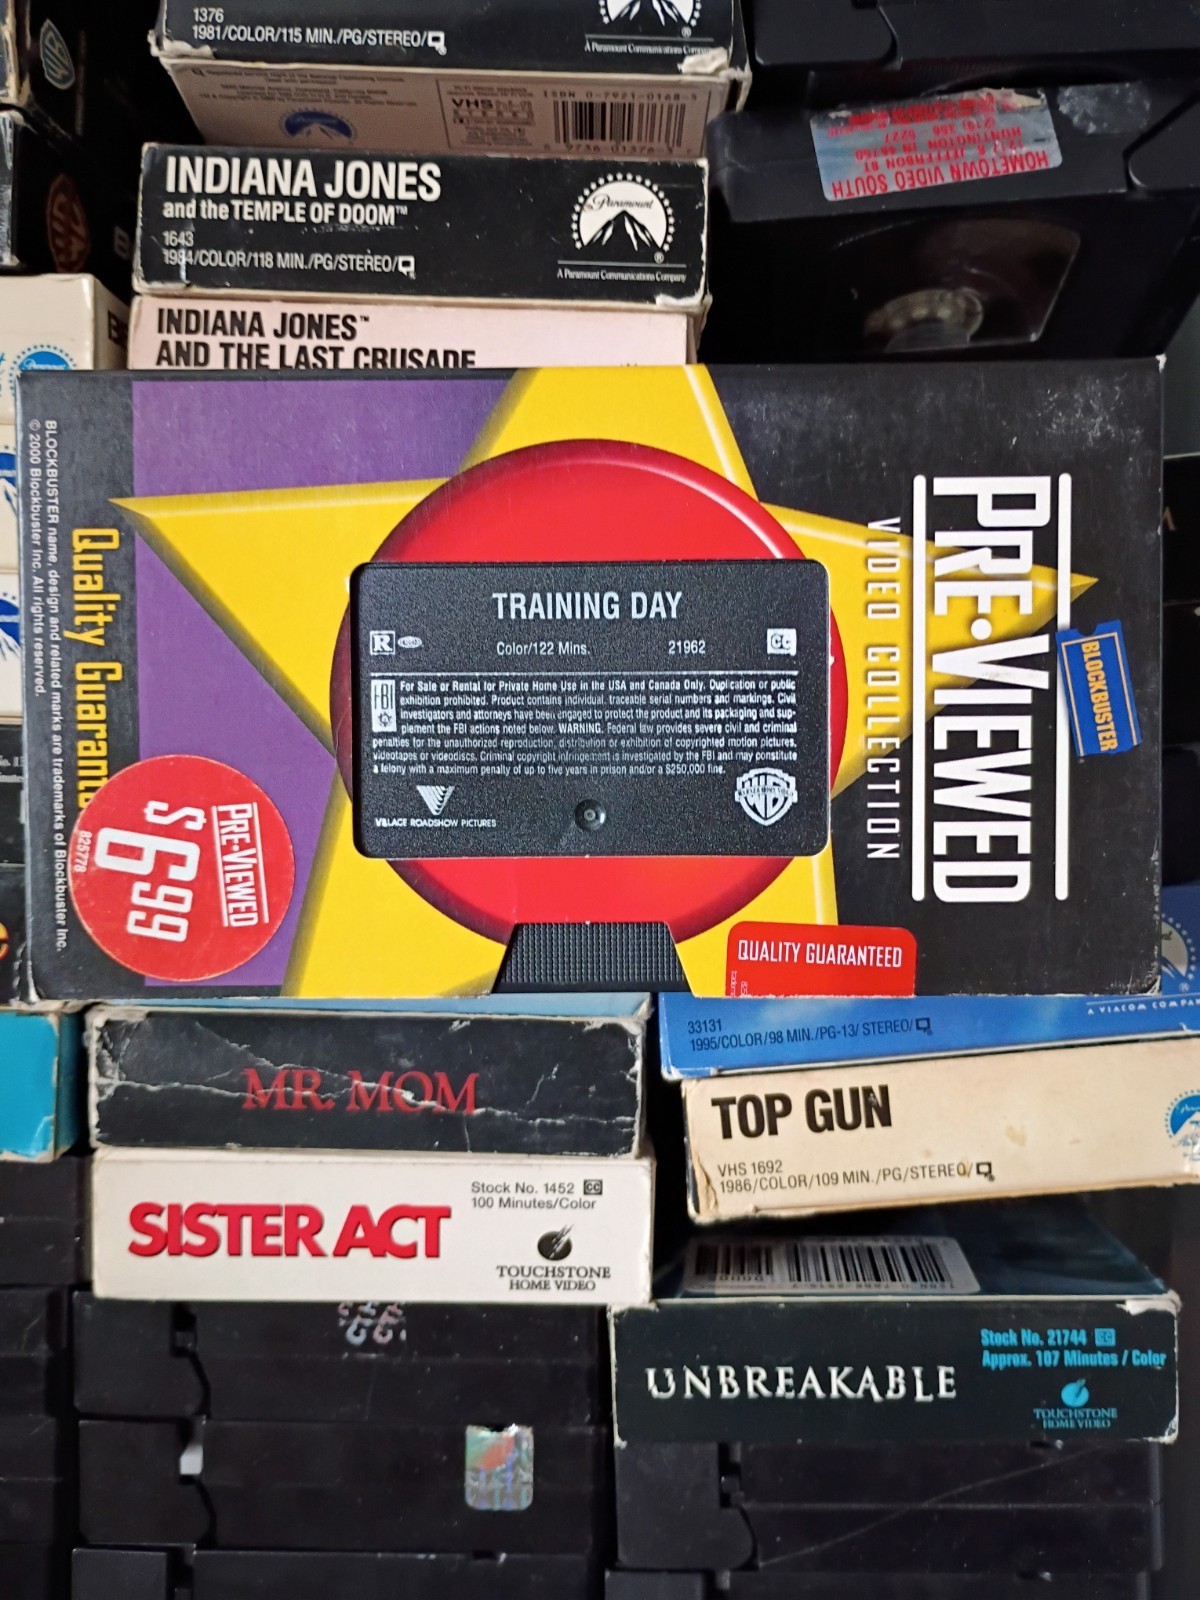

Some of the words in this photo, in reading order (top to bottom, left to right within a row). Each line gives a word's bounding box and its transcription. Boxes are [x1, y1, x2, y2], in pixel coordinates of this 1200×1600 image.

[194, 7, 224, 23] 1376
[192, 25, 302, 43] 1981/COLOR/115
[305, 28, 428, 47] MIN./PG/STEREO/
[949, 150, 1048, 183] HOMETOWN
[165, 156, 317, 197] INDIANA
[325, 160, 441, 201] JONES
[832, 174, 887, 198] SOUTH
[894, 167, 944, 189] VIDEO
[163, 199, 196, 218] and
[201, 199, 229, 220] the
[231, 200, 305, 222] TEMPLE
[310, 203, 335, 223] OF
[592, 193, 654, 210] Paramount
[163, 231, 194, 247] 1643
[277, 253, 398, 272] MIN./PG/STEREO/
[564, 269, 599, 279] Paramount
[656, 272, 686, 282] Company
[157, 308, 264, 337] INDIANA
[156, 340, 209, 367] AND
[220, 342, 270, 369] THE
[280, 345, 344, 369] LAST
[353, 347, 476, 368] CRUSADE
[29, 434, 41, 464] 2000
[45, 420, 60, 523] BLOCKBUSTER
[30, 468, 43, 546] Blockbuster
[46, 527, 58, 566] name,
[32, 550, 44, 572] Inc.
[867, 518, 900, 619] VIDEO
[32, 576, 45, 593] All
[47, 570, 61, 613] design
[63, 528, 122, 646] Quality
[30, 597, 45, 634] rights
[493, 592, 620, 620] TRAINING
[632, 591, 683, 620] DAY
[49, 617, 61, 640] and
[497, 641, 554, 655] Color/122
[558, 640, 590, 655] Mins.
[668, 640, 705, 654] 21962
[34, 637, 47, 697] reserved.
[50, 645, 62, 686] related
[400, 681, 414, 691] For
[418, 681, 436, 691] Sale
[440, 683, 449, 691] or
[453, 681, 480, 691] Rental
[499, 681, 529, 691] Private
[532, 681, 557, 691] Home
[561, 681, 576, 691] Use
[580, 681, 588, 690] in
[592, 681, 604, 690] the
[609, 680, 626, 690] USA
[630, 680, 645, 690] and
[649, 680, 680, 690] Canada
[759, 680, 768, 689] or
[771, 679, 796, 691] public
[1080, 641, 1118, 751] BLOCKBUSTER
[52, 692, 63, 730] marks
[400, 695, 441, 706] exhibition
[444, 695, 488, 706] prohibited.
[492, 695, 524, 706] Product
[715, 694, 729, 704] and
[400, 709, 453, 721] investigators
[456, 710, 471, 720] and
[474, 710, 512, 721] attorneys
[636, 708, 648, 719] the
[651, 709, 683, 719] product
[685, 709, 700, 718] and
[715, 708, 757, 720] packaging
[759, 708, 774, 717] and
[454, 724, 467, 733] FBI
[744, 722, 759, 732] and
[52, 735, 62, 754] are
[428, 738, 441, 748] the
[445, 738, 497, 748] unauthorized
[867, 647, 900, 859] COLLECTION
[756, 751, 797, 761] constitute
[437, 764, 478, 774] maximum
[601, 764, 626, 775] prison
[53, 758, 66, 830] trademarks
[410, 818, 458, 827] ROADSHOW
[462, 819, 496, 828] PICTURES
[55, 833, 66, 846] of
[74, 830, 92, 873] 825778
[55, 850, 68, 925] Blockbuster
[56, 928, 68, 952] Inc.
[738, 939, 800, 962] QUALITY
[806, 943, 902, 968] GUARANTEED
[1099, 1004, 1146, 1013] VIACOM
[688, 1019, 722, 1034] 33131
[690, 1030, 783, 1051] 1995/COLOR/98
[787, 1023, 859, 1043] MIN./PG-13/
[863, 1019, 913, 1036] STEREO/
[242, 1068, 335, 1112] MR.
[345, 1070, 479, 1116] MOM
[711, 1093, 792, 1140] TOP
[805, 1085, 892, 1133] GUN
[718, 1162, 747, 1177] VHS
[751, 1160, 783, 1174] 1692
[720, 1171, 839, 1194] 1986/COLOR/109
[843, 1163, 973, 1185] MIN./PG/STEREO/
[471, 1181, 510, 1194] Stock
[515, 1182, 538, 1194] No.
[544, 1183, 574, 1194] 1452
[472, 1197, 494, 1208] 100
[499, 1197, 596, 1209] Minutes/Color
[128, 1202, 328, 1258] SISTER
[333, 1204, 451, 1259] ACT
[496, 1265, 611, 1279] TOUCHSTONE
[509, 1279, 550, 1290] HOME
[555, 1280, 595, 1291] VIDEO
[981, 1328, 1017, 1346] Stock
[1021, 1329, 1044, 1346] No.
[1047, 1329, 1087, 1346] 21744
[982, 1350, 1032, 1371] Approx.
[1036, 1350, 1060, 1366] 107
[1064, 1350, 1118, 1366] Minutes
[1132, 1350, 1166, 1367] Color
[645, 1365, 957, 1403] UNBREAKABLE
[1033, 1408, 1118, 1419] TOUCHSTONE
[1043, 1419, 1075, 1429] HOME
[1077, 1419, 1111, 1429] VIDEO
